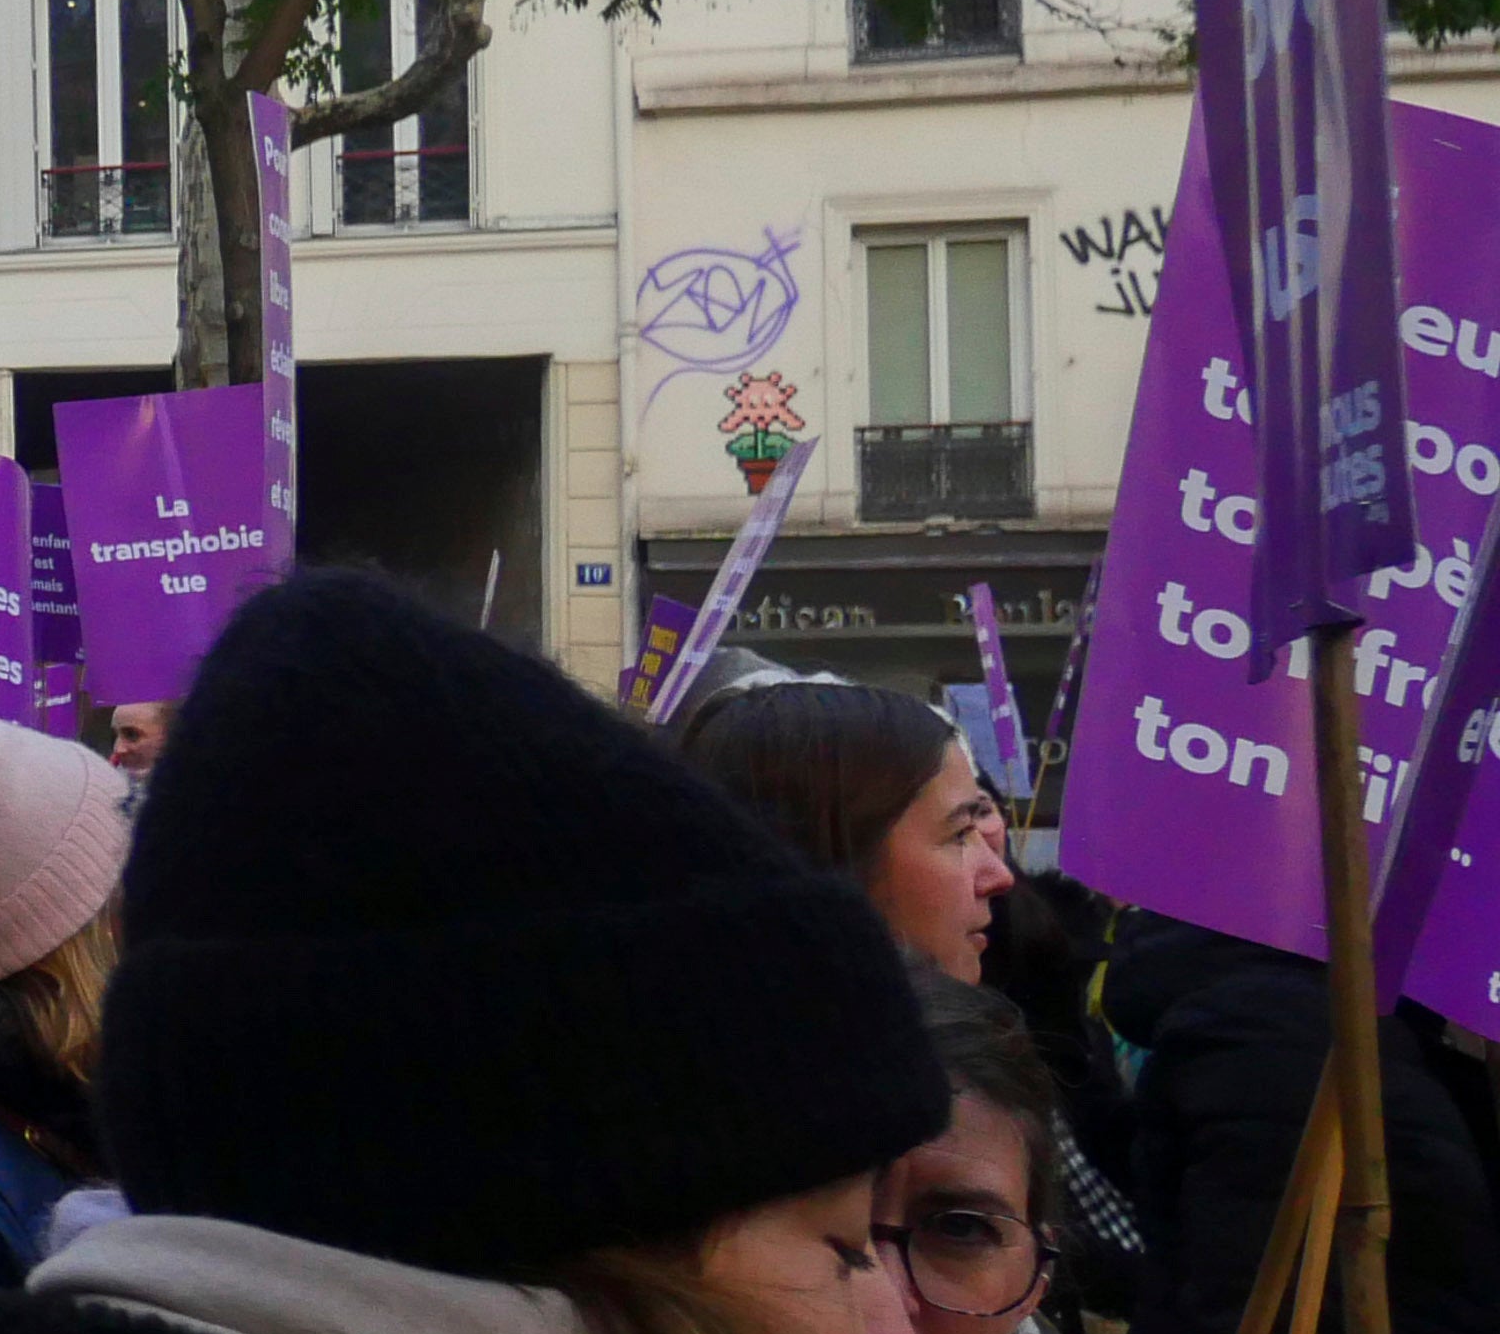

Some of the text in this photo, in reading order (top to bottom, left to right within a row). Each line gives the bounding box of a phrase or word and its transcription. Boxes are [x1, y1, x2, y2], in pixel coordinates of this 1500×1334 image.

[156, 495, 189, 518] La
[90, 525, 264, 563] transphobie
[160, 573, 207, 595] tue
[1134, 696, 1289, 796] ton
